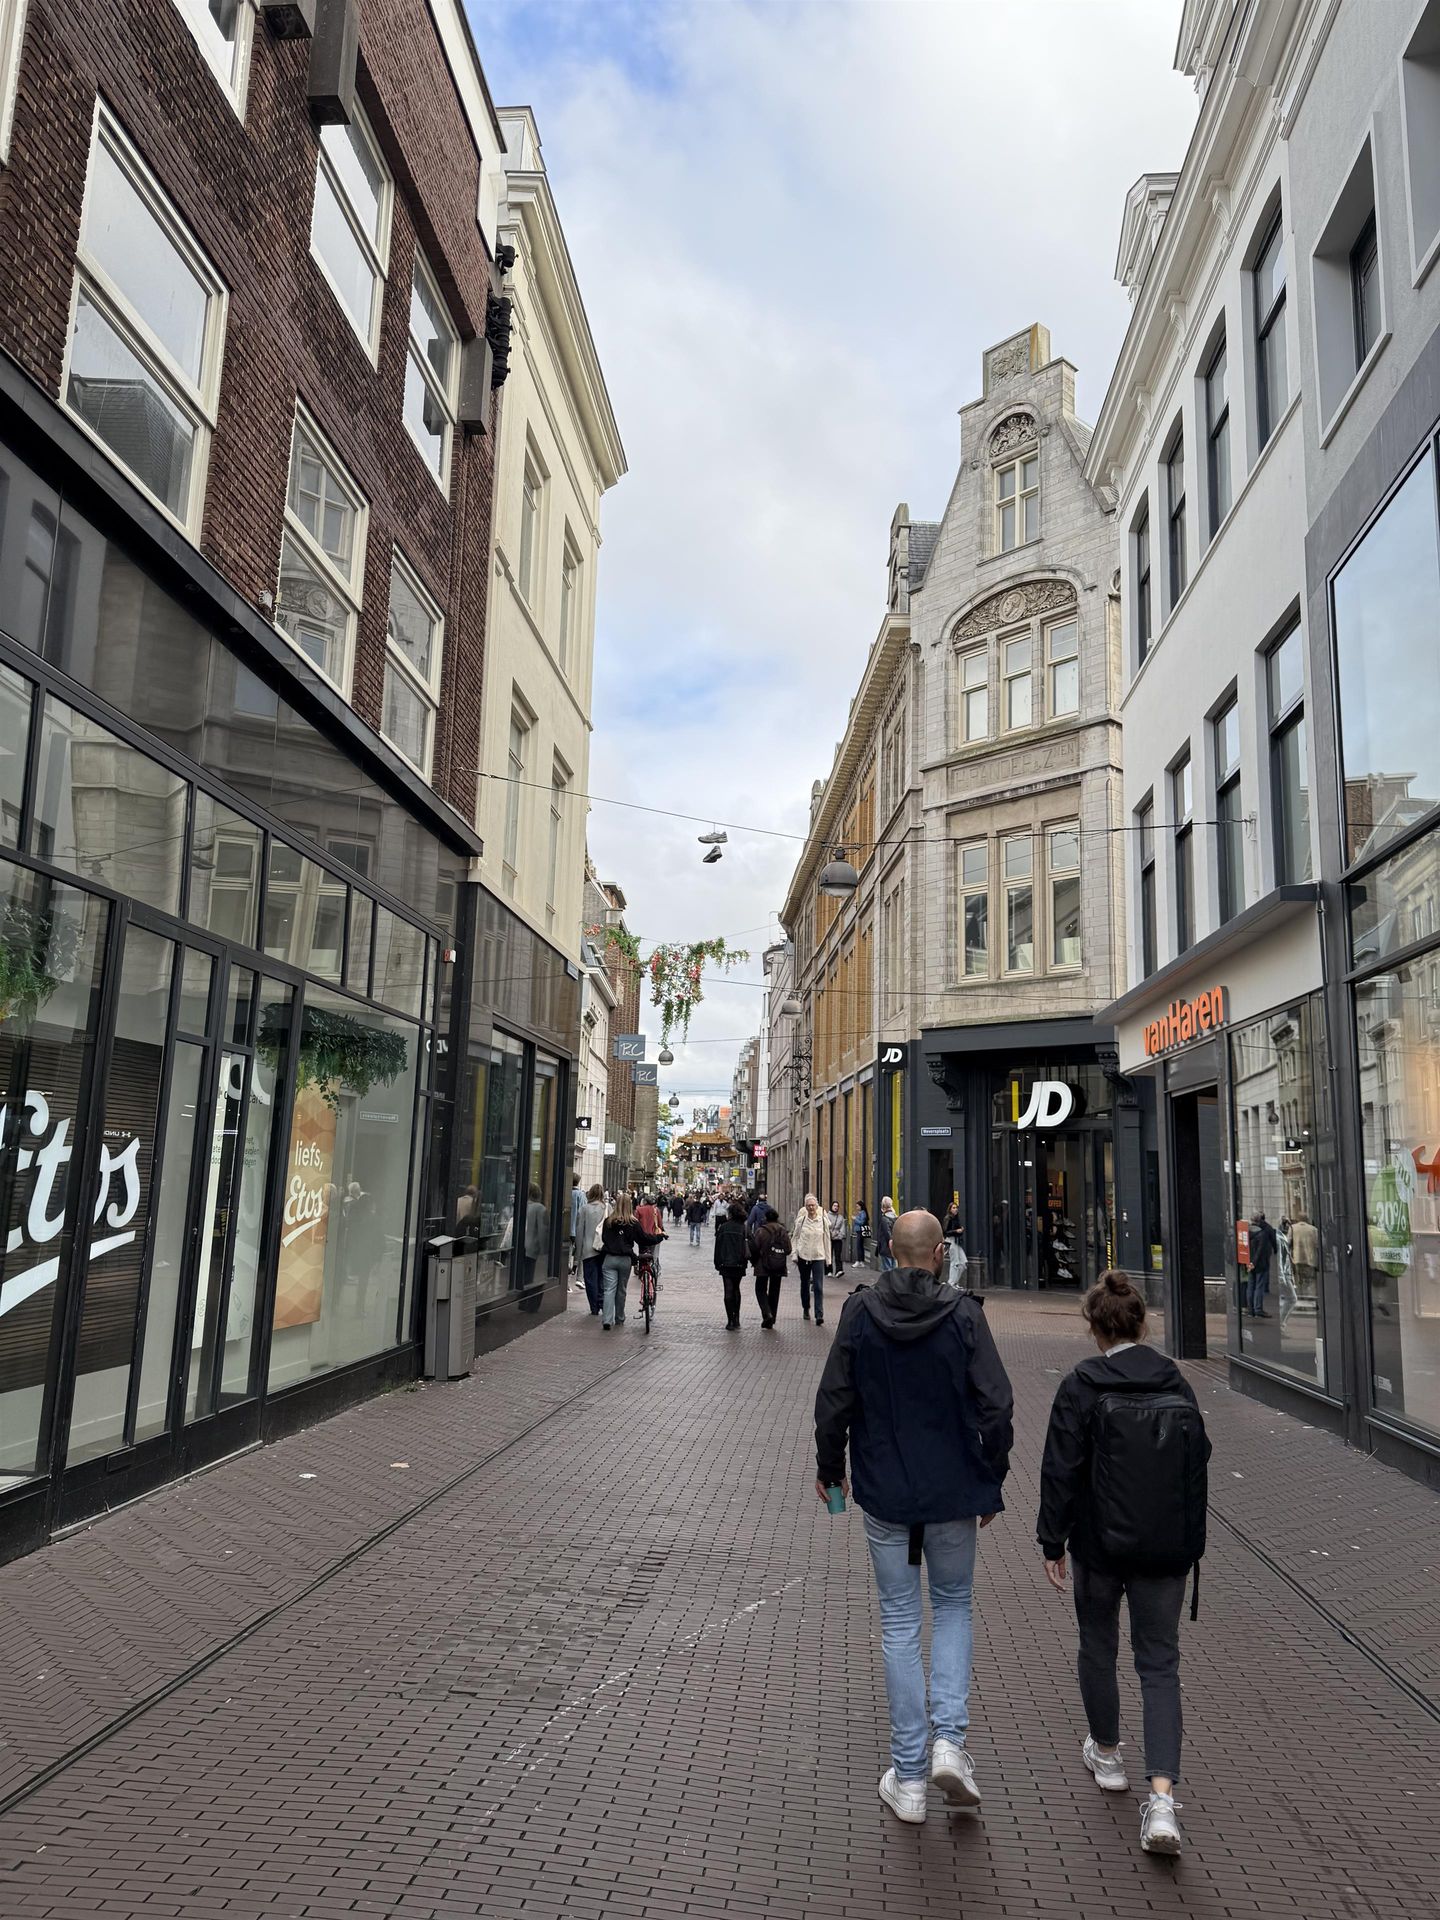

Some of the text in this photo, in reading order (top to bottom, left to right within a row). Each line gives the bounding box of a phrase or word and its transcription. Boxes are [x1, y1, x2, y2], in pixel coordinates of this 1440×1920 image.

[1143, 985, 1224, 1057] vanHaren
[881, 1047, 903, 1063] JD
[1017, 1080, 1073, 1130] JD
[294, 1139, 324, 1171] liefs,
[284, 1174, 323, 1225] Etos
